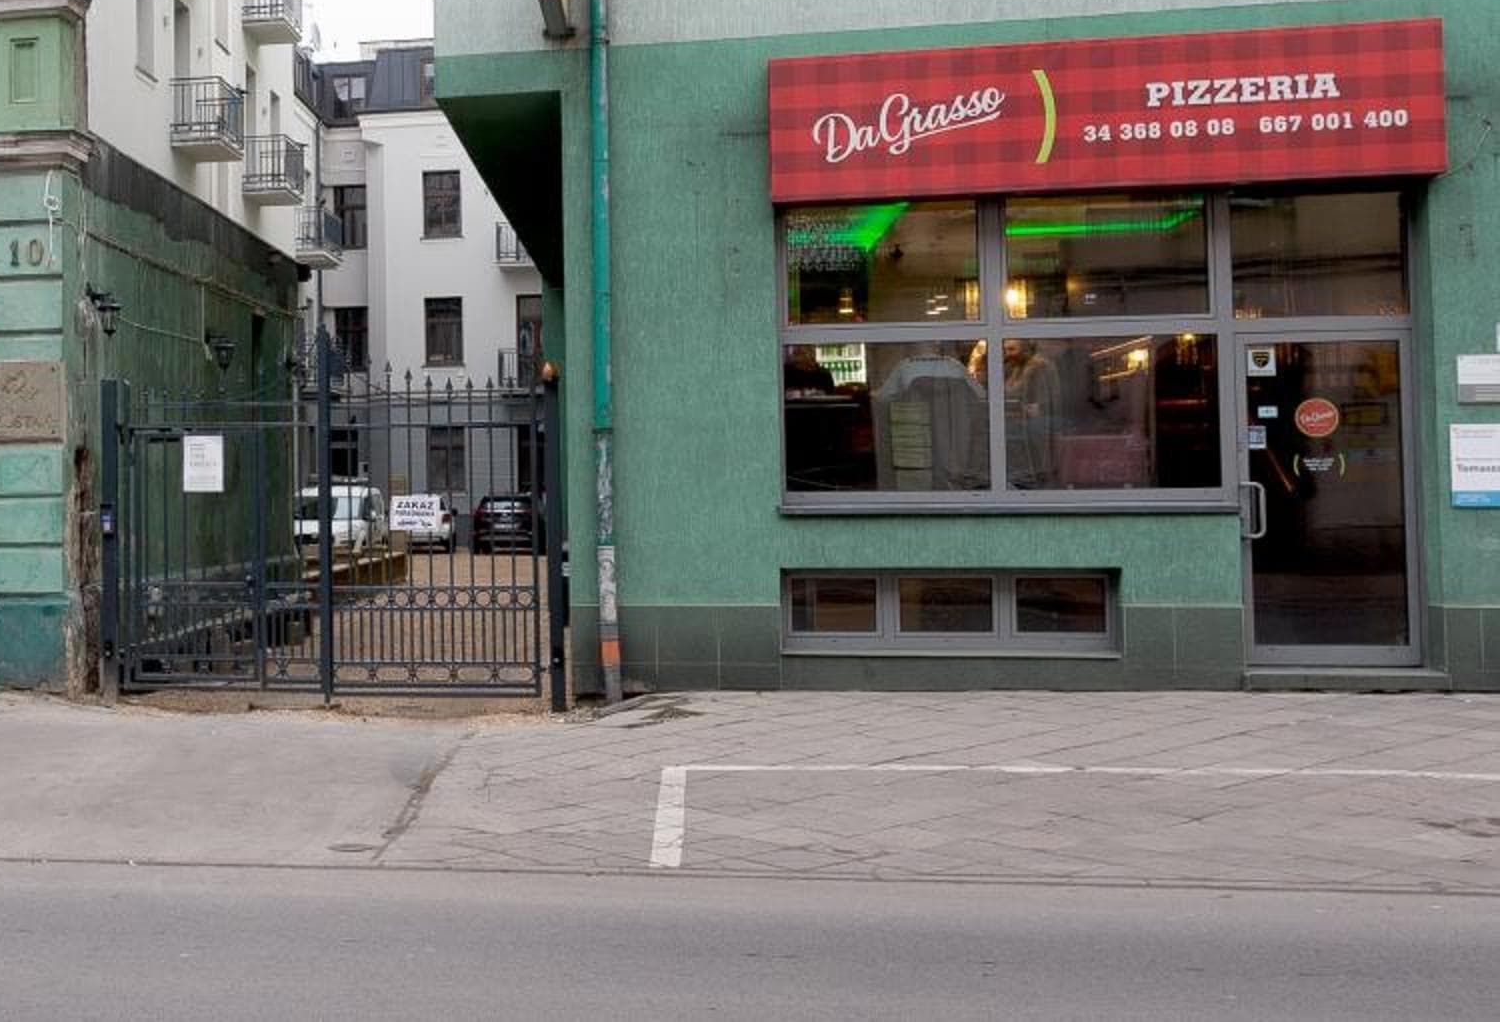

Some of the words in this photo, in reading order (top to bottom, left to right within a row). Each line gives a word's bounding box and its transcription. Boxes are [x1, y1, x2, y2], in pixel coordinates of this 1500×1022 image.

[1145, 73, 1340, 107] PIZZERIA
[1083, 125, 1112, 142] 34
[1119, 122, 1162, 140] 368
[1169, 120, 1198, 138] 08
[1206, 118, 1235, 136] 08
[1258, 115, 1302, 133] 667
[1311, 112, 1353, 131] 001
[1364, 109, 1408, 128] 400
[9, 239, 44, 267] 10
[396, 501, 434, 509] ZAKAZ
